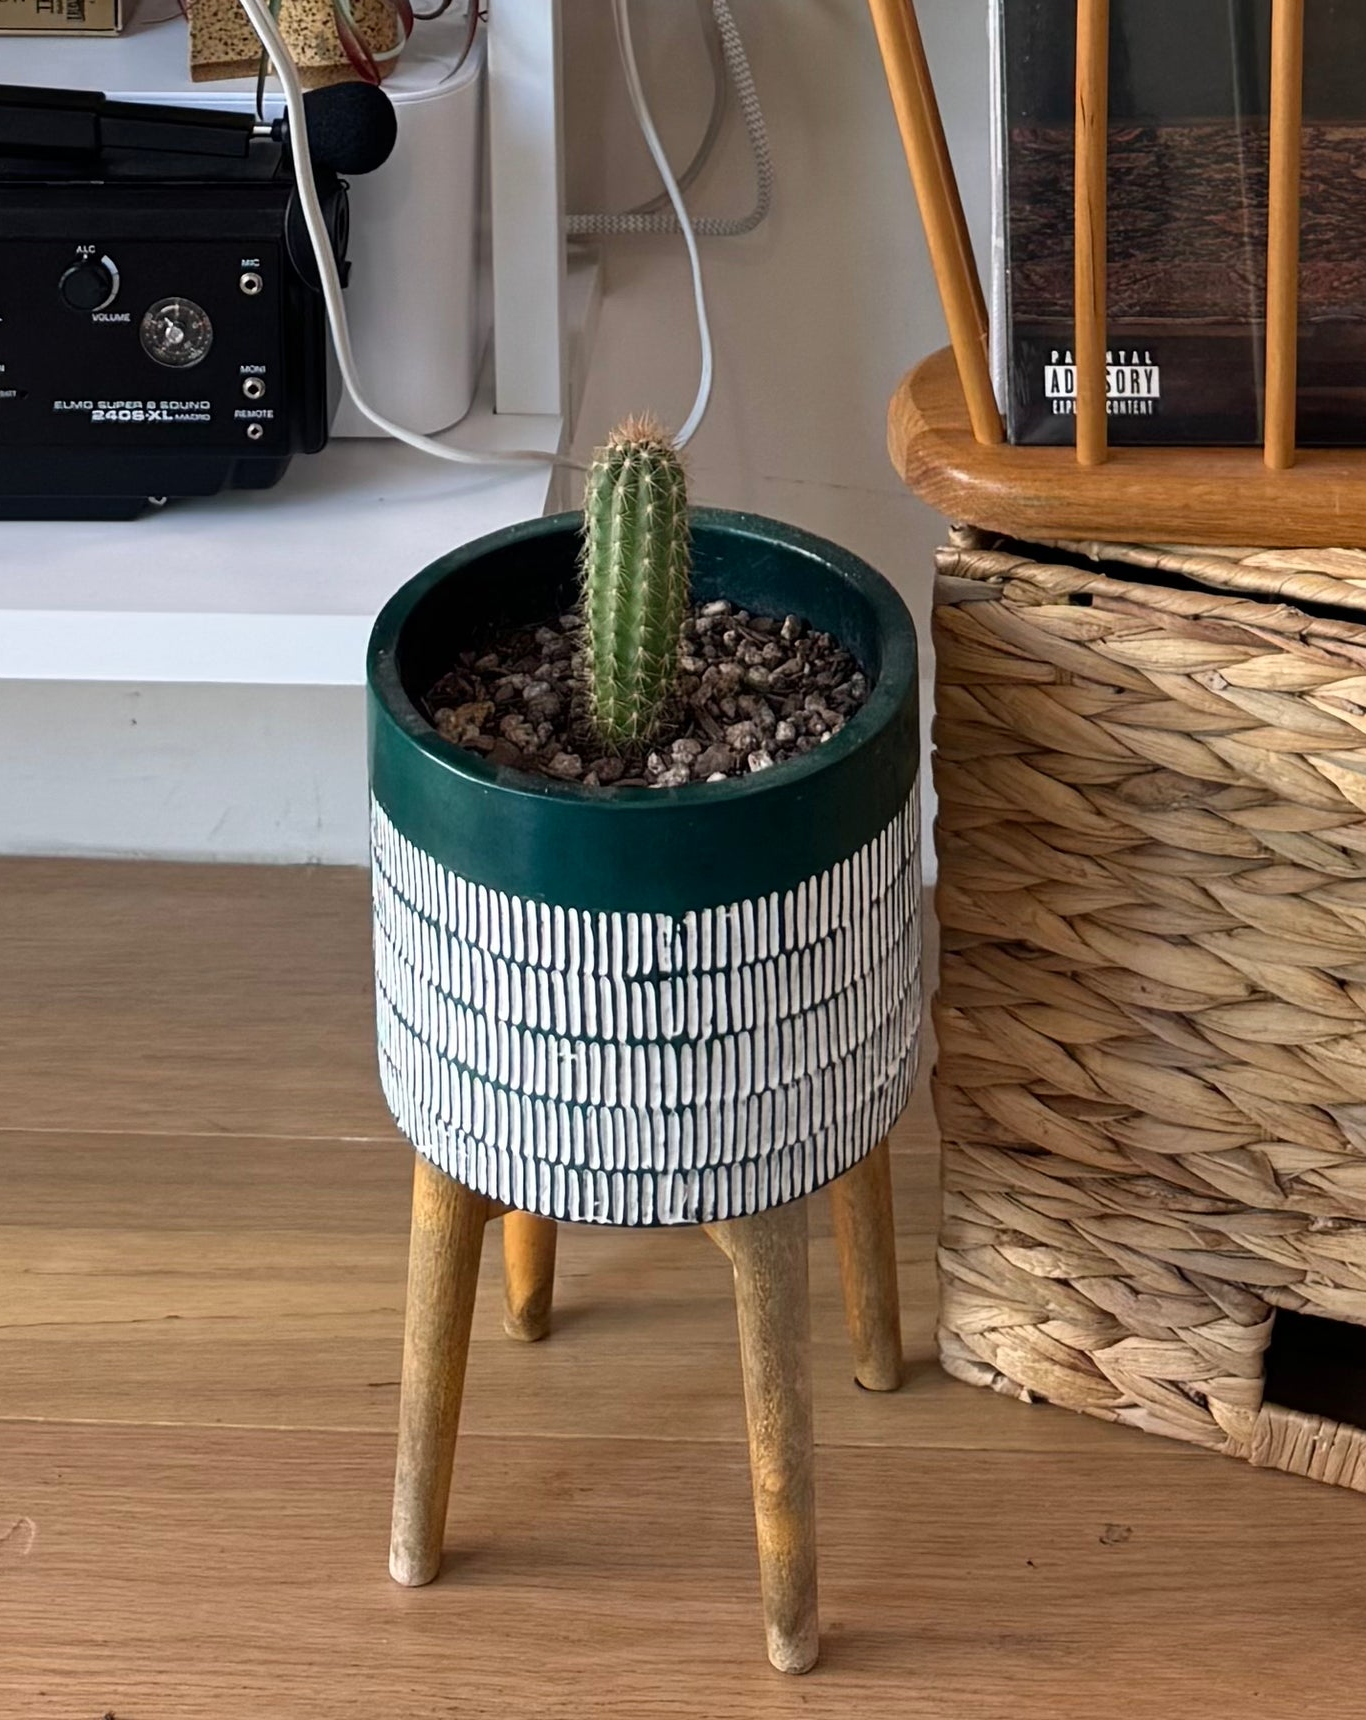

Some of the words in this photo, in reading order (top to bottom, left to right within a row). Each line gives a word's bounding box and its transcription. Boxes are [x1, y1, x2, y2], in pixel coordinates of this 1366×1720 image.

[240, 258, 261, 268] MIC
[91, 312, 131, 322] VOLUME
[1050, 349, 1153, 364] PANTAL
[1050, 367, 1153, 395] ADSORY
[53, 400, 94, 410] ELMO
[97, 400, 143, 410] SUPER
[159, 400, 211, 410] SOUND
[1105, 399, 1153, 415] CONTENT
[174, 412, 211, 422] MACRO
[233, 409, 274, 419] REMOTE
